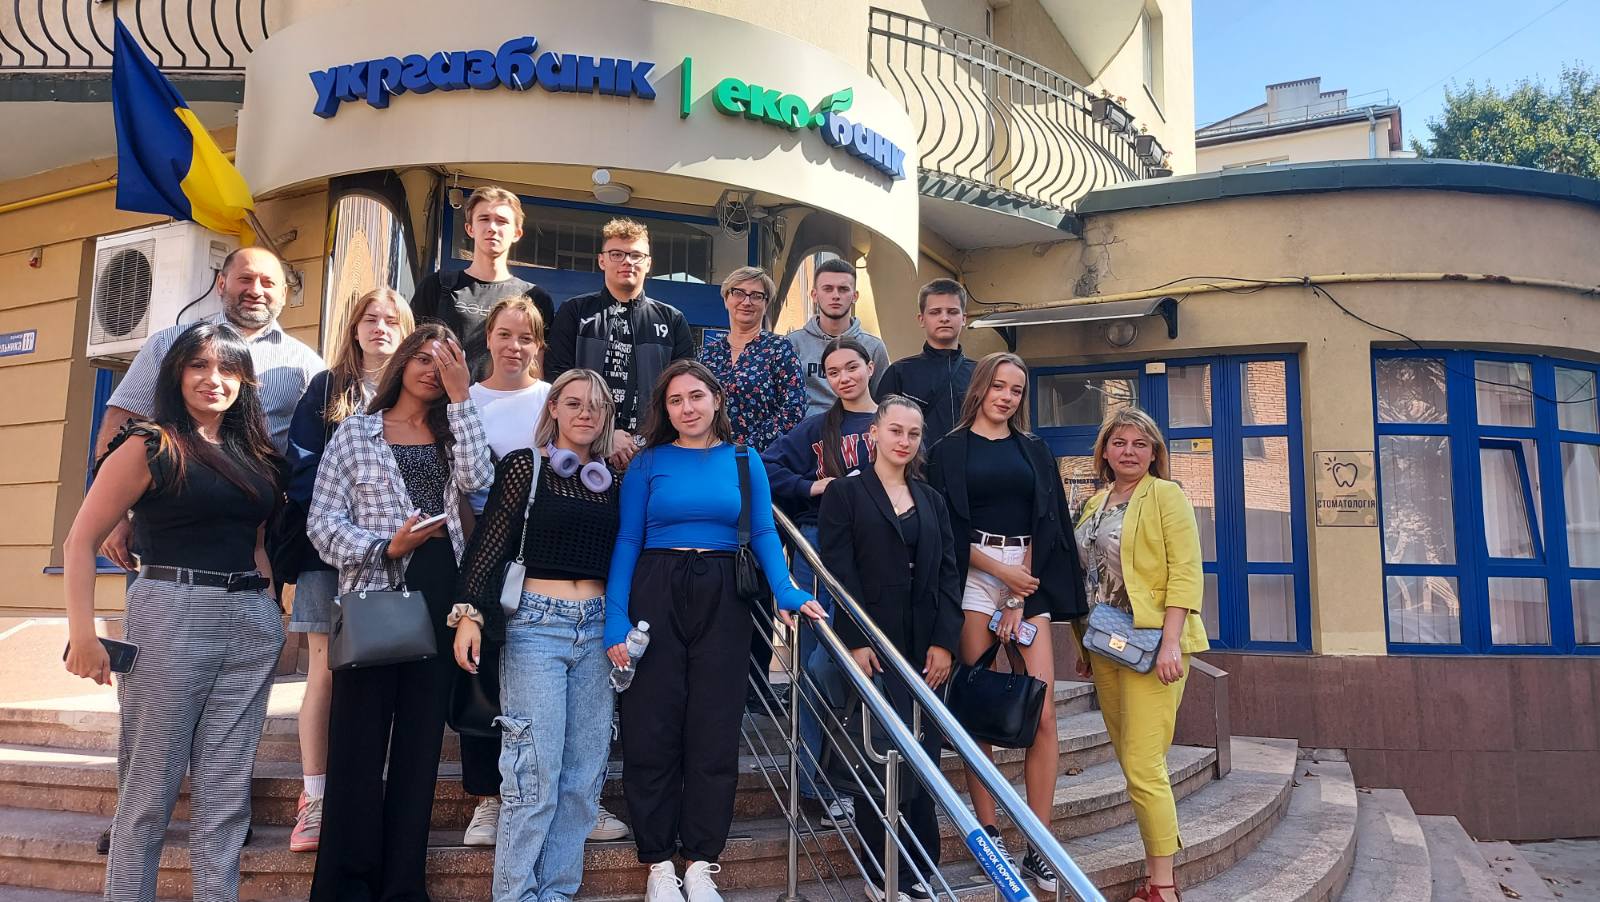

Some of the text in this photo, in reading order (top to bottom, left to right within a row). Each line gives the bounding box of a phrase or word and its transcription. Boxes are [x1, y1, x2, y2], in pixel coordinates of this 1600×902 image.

[309, 36, 657, 119] укргазбанк
[653, 323, 669, 338] 19
[1316, 499, 1376, 508] СТОМАТОЛОГІЯ
[975, 836, 998, 865] ПОЧАТОК
[996, 864, 1021, 893] ПОРУЧНЯ
